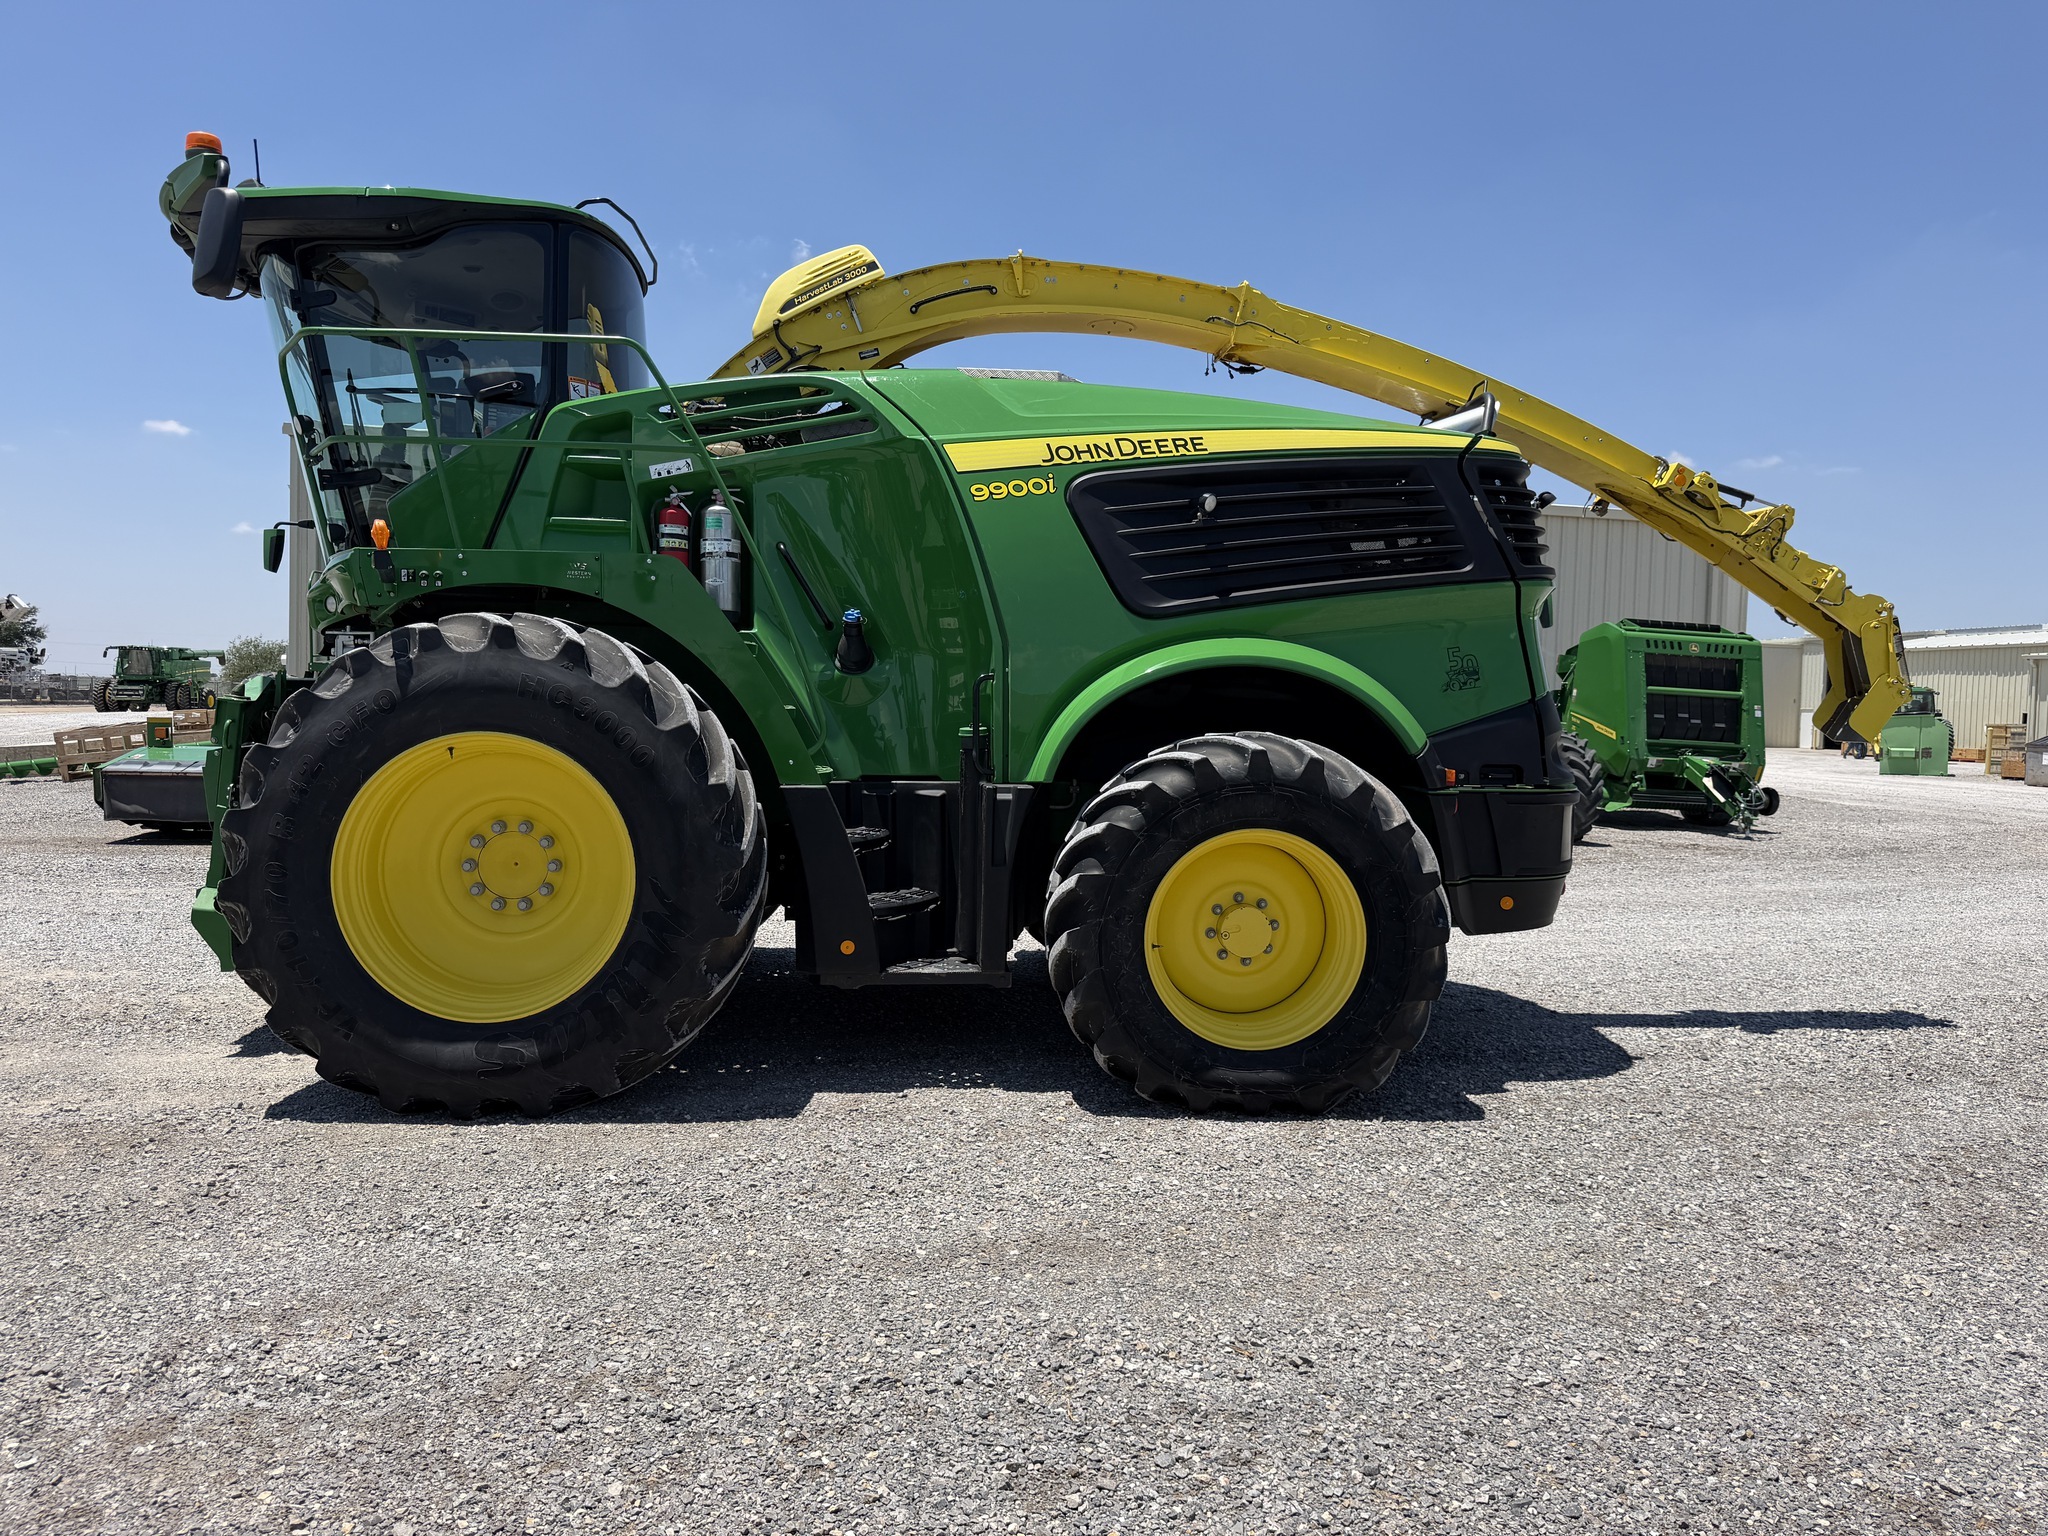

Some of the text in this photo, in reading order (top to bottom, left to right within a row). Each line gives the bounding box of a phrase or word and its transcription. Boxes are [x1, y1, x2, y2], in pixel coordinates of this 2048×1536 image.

[794, 266, 868, 305] HarvestLab 3000
[1041, 436, 1208, 464] JOHN DEERE
[969, 472, 1057, 501] 9900i
